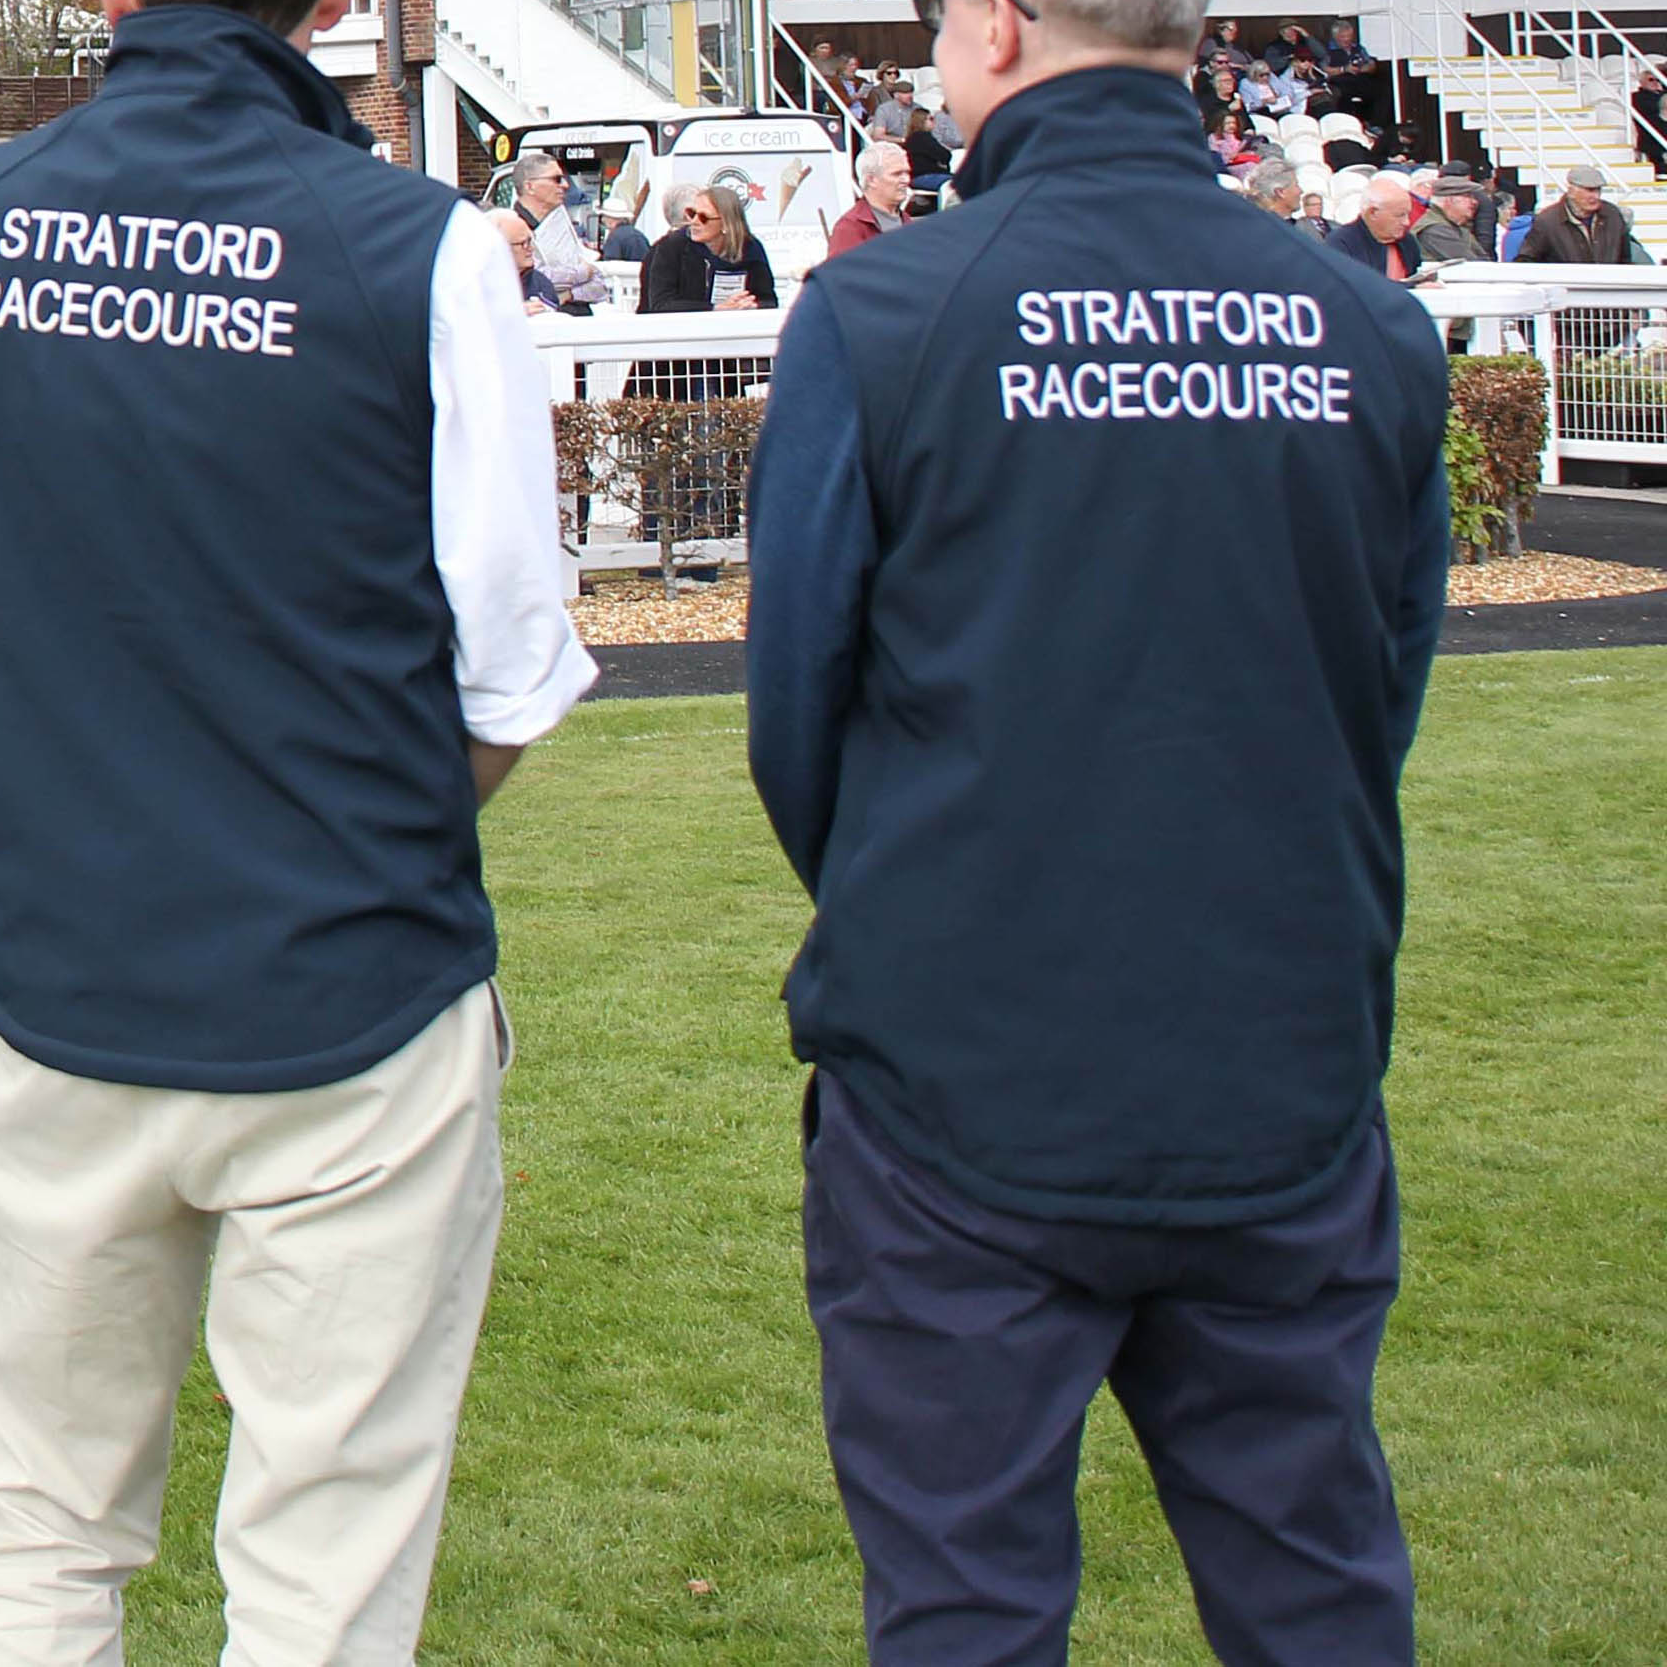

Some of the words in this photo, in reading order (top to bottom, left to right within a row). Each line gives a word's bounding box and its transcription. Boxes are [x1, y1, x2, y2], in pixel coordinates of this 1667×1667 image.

[704, 130, 734, 147] ice
[740, 129, 801, 147] cream
[1017, 290, 1323, 348] STRATFORD
[998, 361, 1351, 423] RACECOURSE
